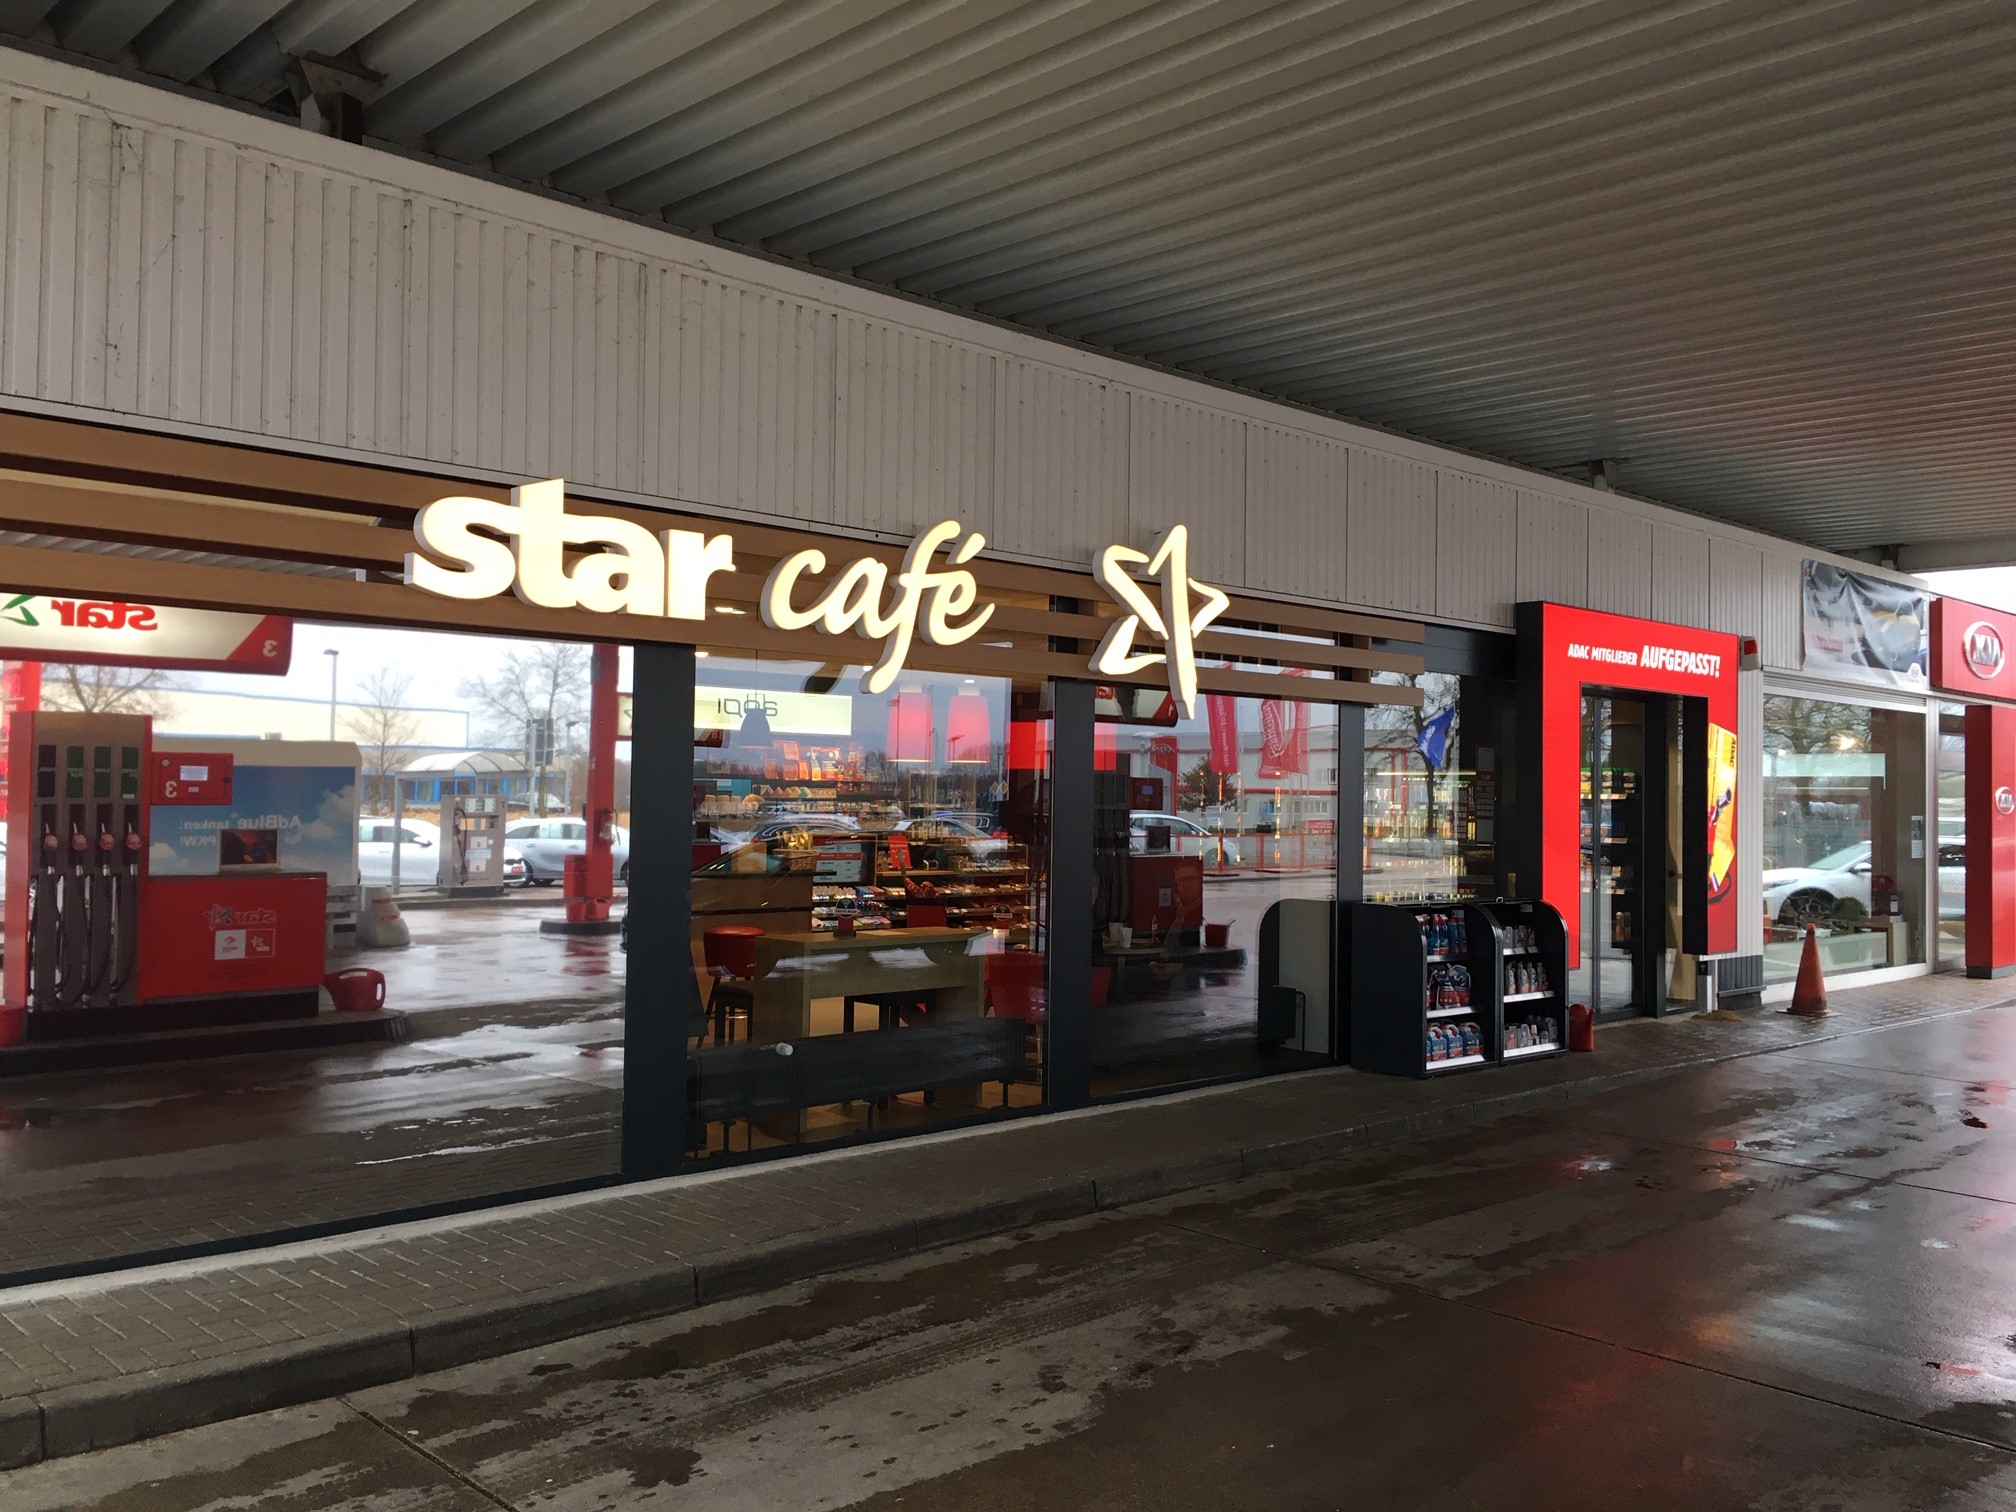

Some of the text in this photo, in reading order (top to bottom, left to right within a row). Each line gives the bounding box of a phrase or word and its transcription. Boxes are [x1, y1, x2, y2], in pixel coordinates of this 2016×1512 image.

[404, 478, 996, 694] star café
[1567, 643, 1721, 678] ADAC MITGLIEDER AUFGEPASST!
[718, 697, 778, 718] IQOS
[1729, 737, 1737, 769] ADAC
